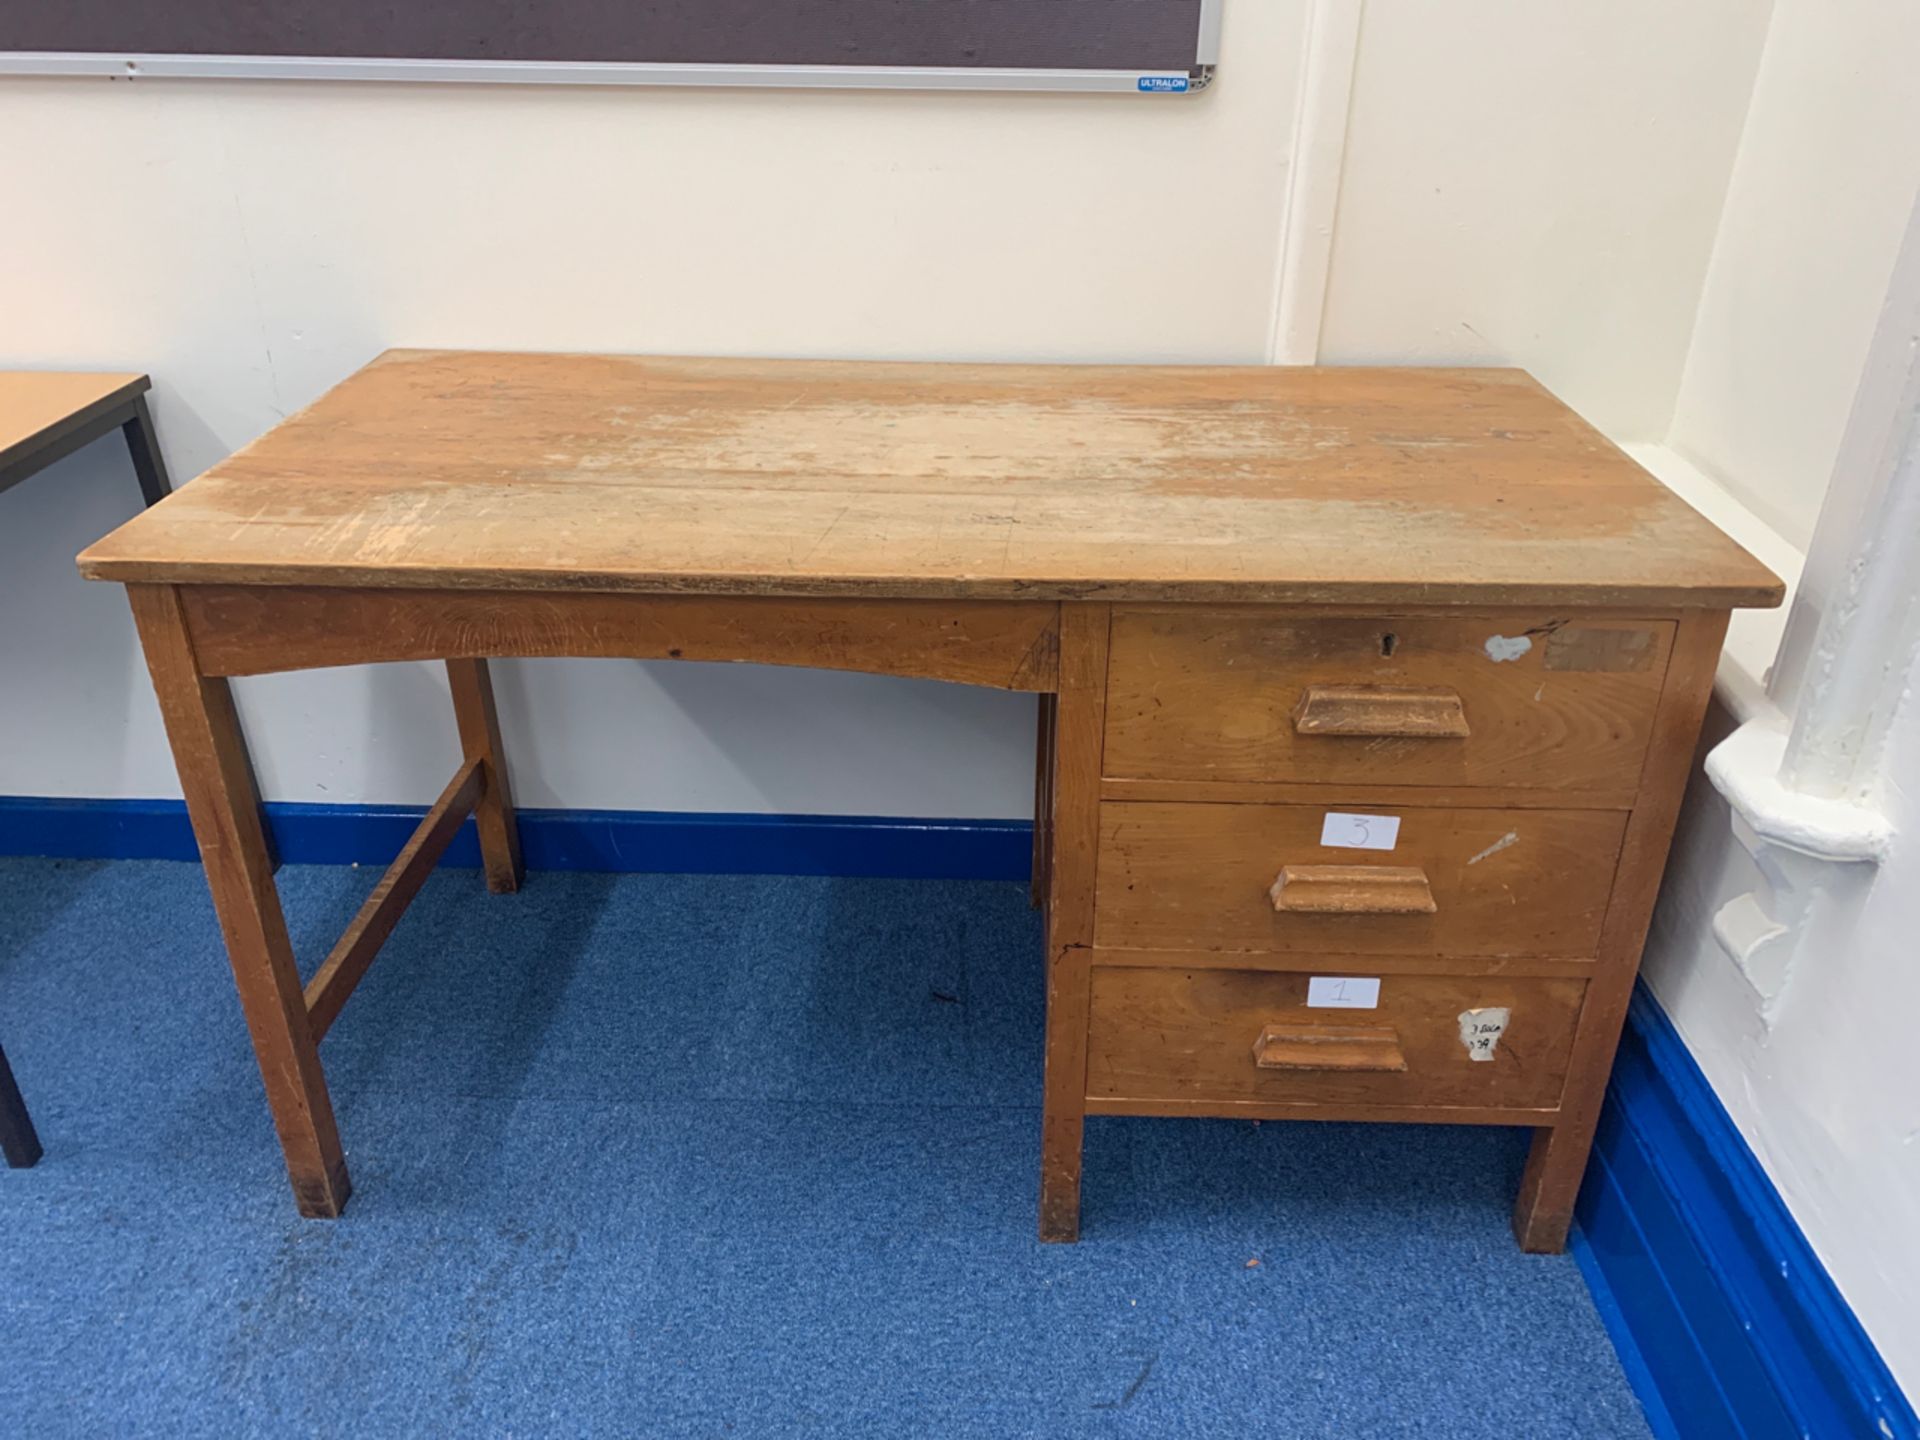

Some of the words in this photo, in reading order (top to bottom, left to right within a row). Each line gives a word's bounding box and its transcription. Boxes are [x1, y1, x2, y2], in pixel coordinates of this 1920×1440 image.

[1141, 79, 1186, 87] ULTRALON
[1347, 817, 1370, 846] 3
[1329, 980, 1352, 1002] 1
